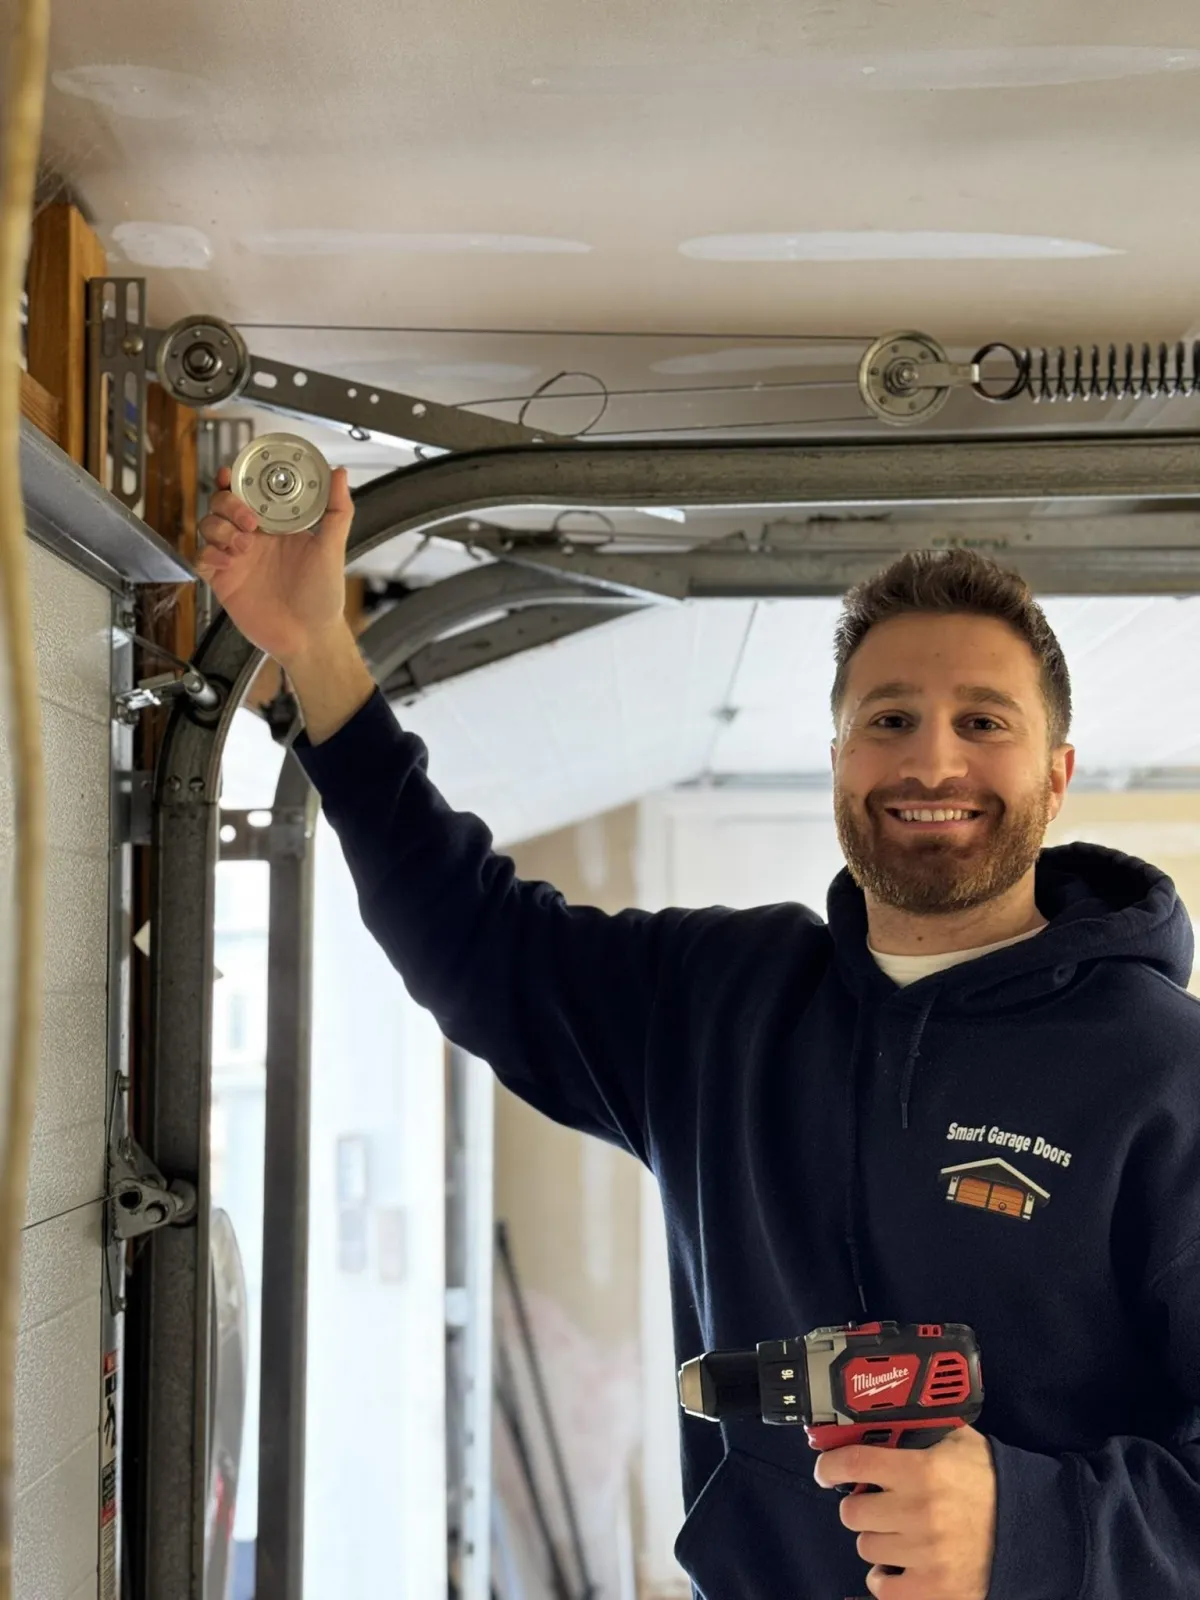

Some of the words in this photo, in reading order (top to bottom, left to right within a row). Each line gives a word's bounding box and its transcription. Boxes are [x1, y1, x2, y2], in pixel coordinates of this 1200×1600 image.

[946, 1122, 986, 1142] Smart
[988, 1126, 1031, 1153] Garage
[1032, 1136, 1072, 1167] Doors
[781, 1369, 794, 1380] 16
[851, 1366, 909, 1393] Milwaukee
[783, 1395, 797, 1405] 14
